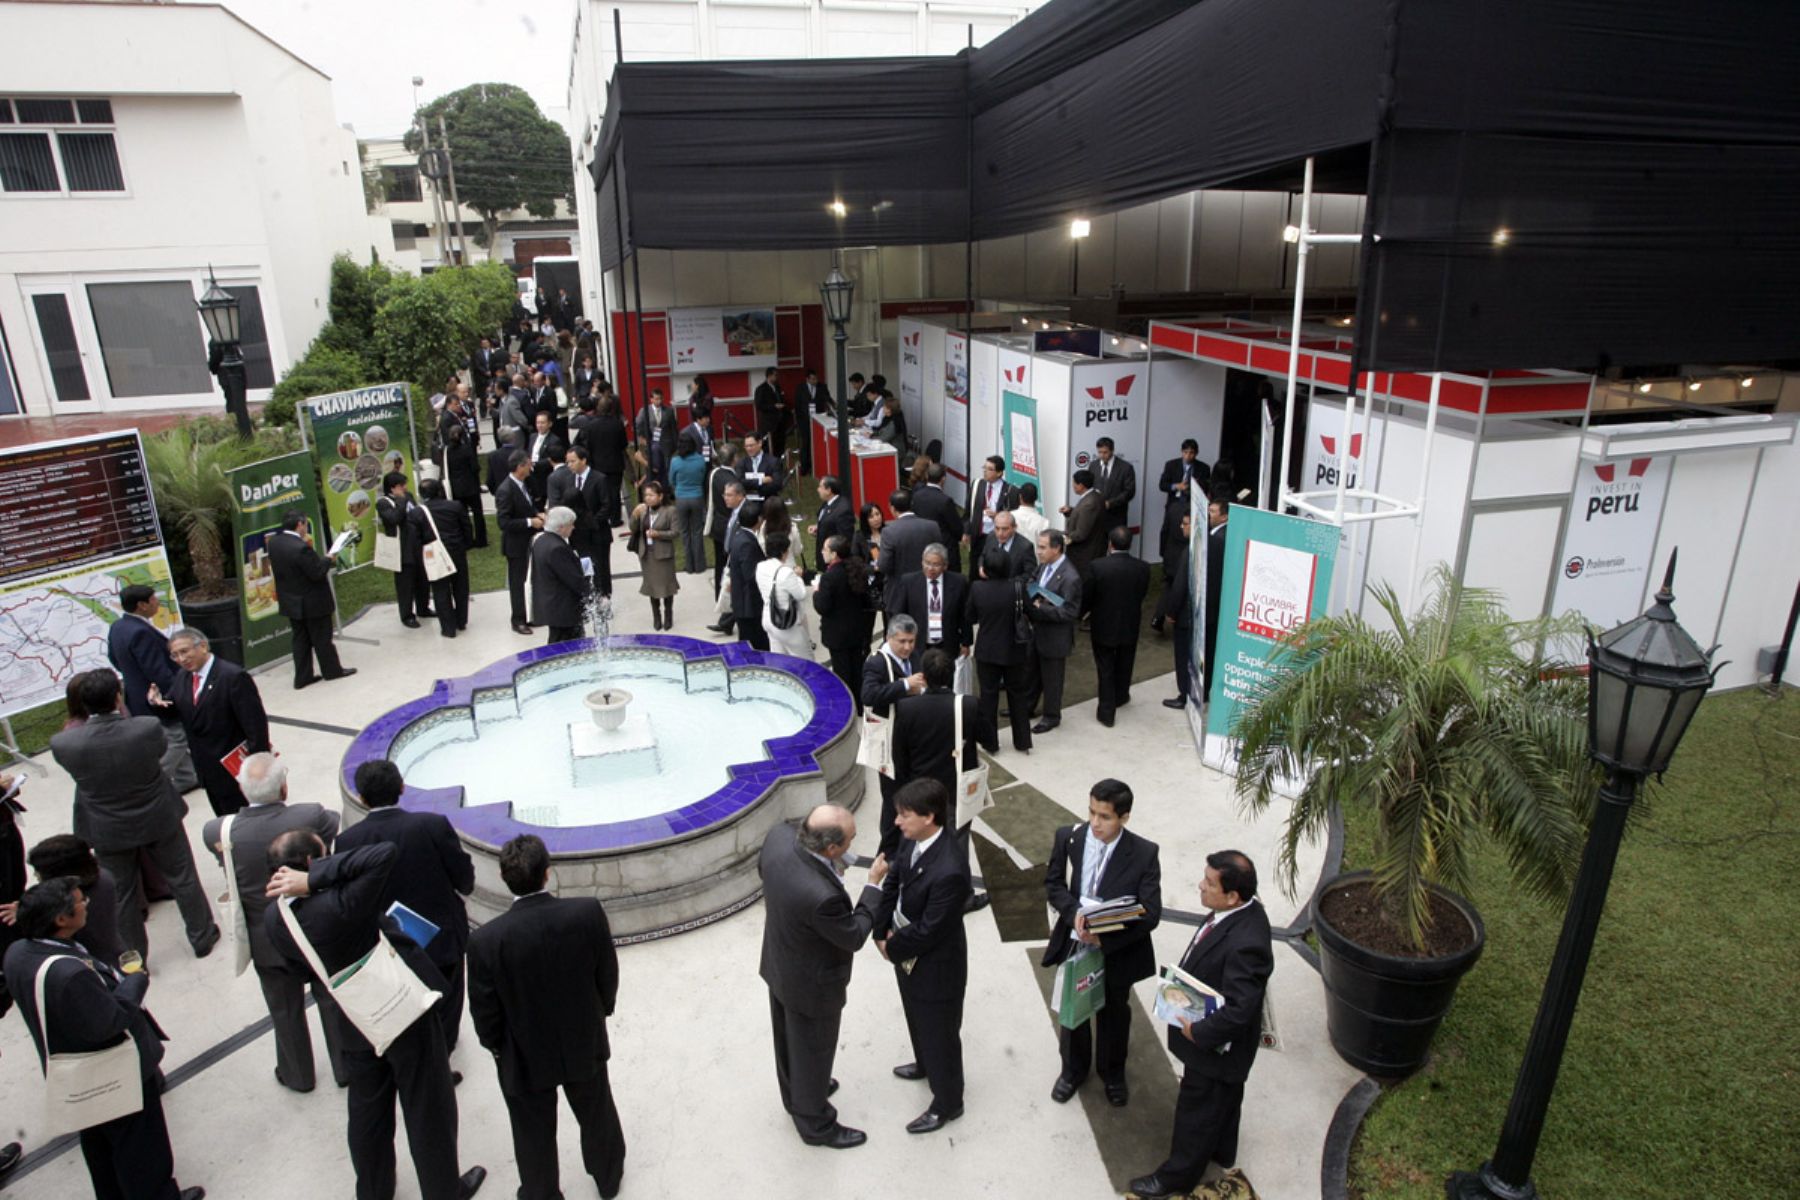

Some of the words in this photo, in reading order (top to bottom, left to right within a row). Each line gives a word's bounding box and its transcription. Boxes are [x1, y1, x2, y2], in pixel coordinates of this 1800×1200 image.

[314, 387, 398, 416] CHAVIMOCHIC
[1085, 400, 1115, 409] INVEST
[1085, 406, 1129, 428] peru
[240, 472, 299, 502] DanPer
[1590, 482, 1626, 495] INVEST
[1628, 481, 1642, 491] IN
[1585, 491, 1640, 522] peru
